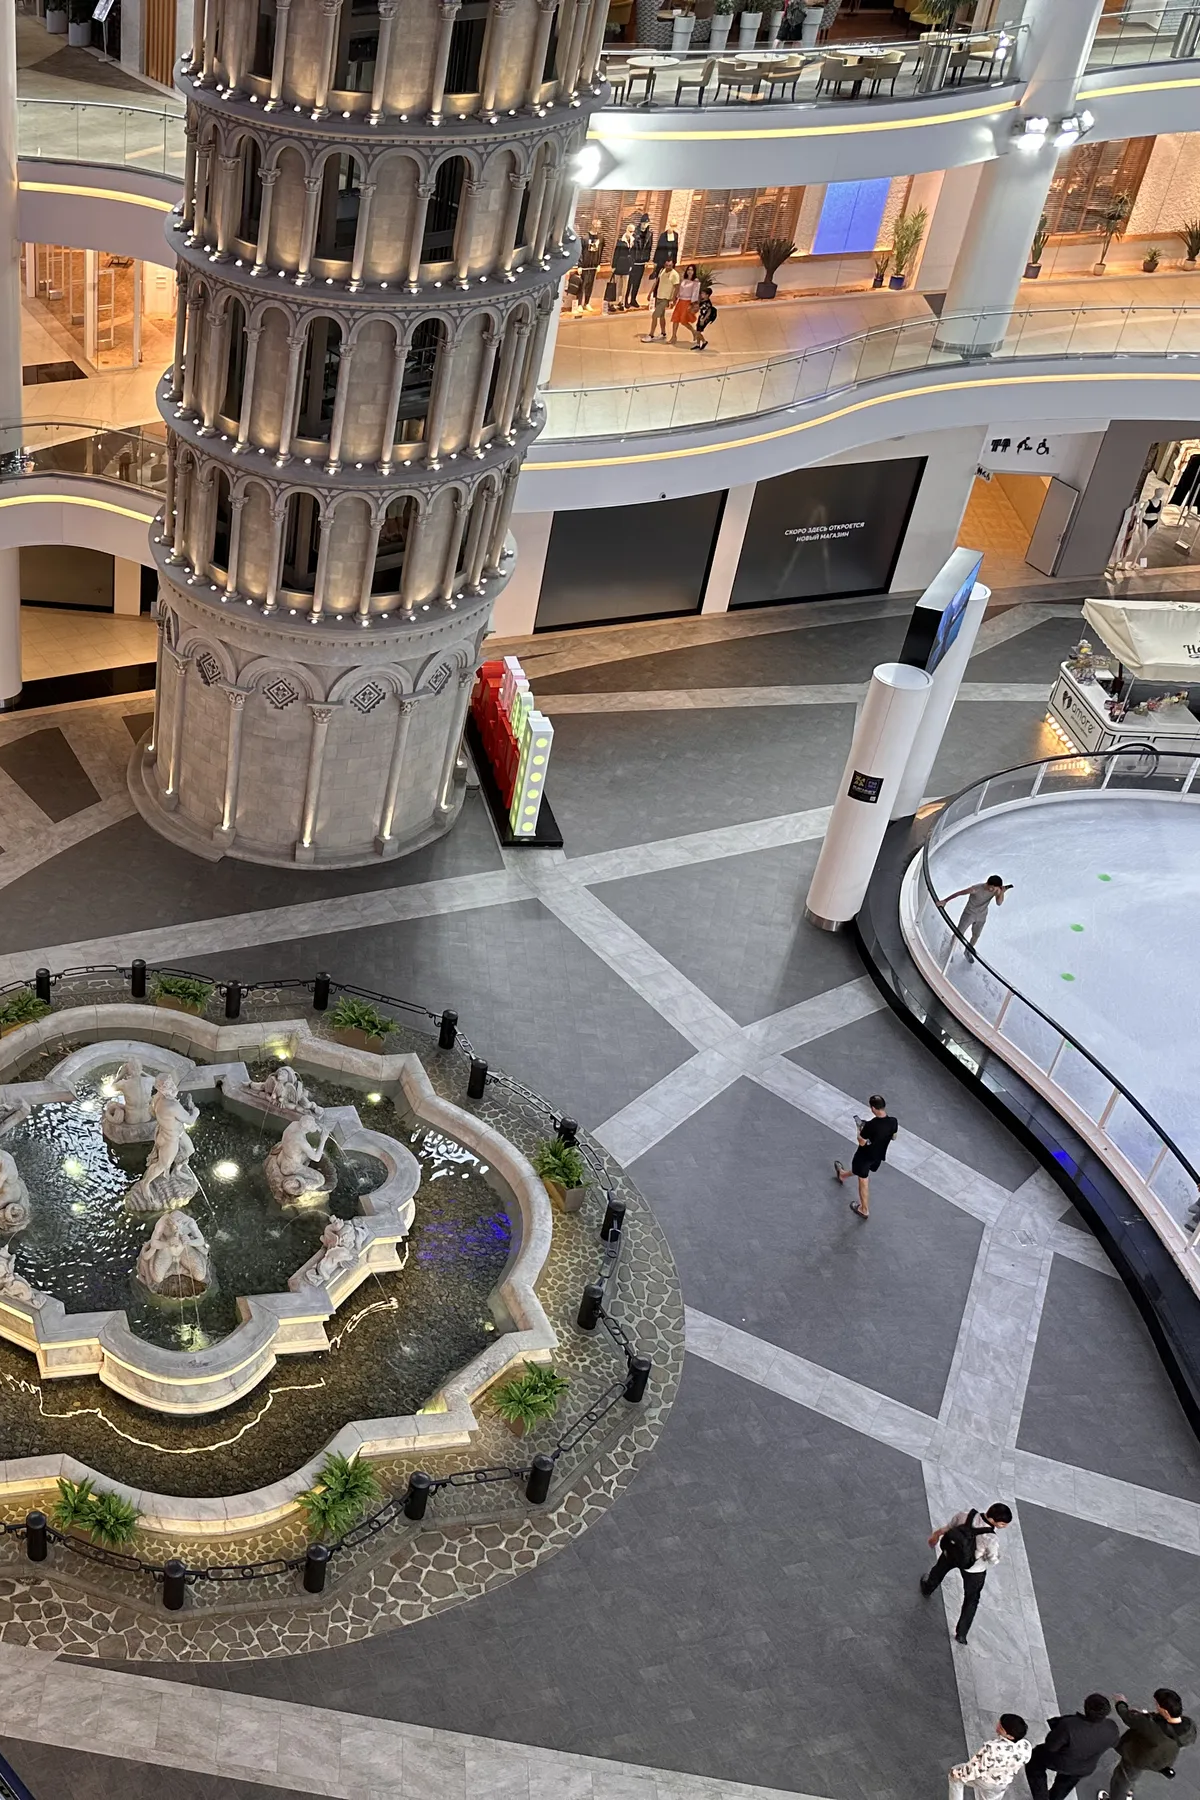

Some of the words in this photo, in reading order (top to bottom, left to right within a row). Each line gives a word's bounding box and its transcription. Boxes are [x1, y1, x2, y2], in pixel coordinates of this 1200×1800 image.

[784, 528, 806, 536] СКОРО
[829, 522, 865, 531] ОТКРОЕТСЯ
[796, 534, 819, 542] НОВЫЙ
[820, 531, 849, 540] МАГАЗИН
